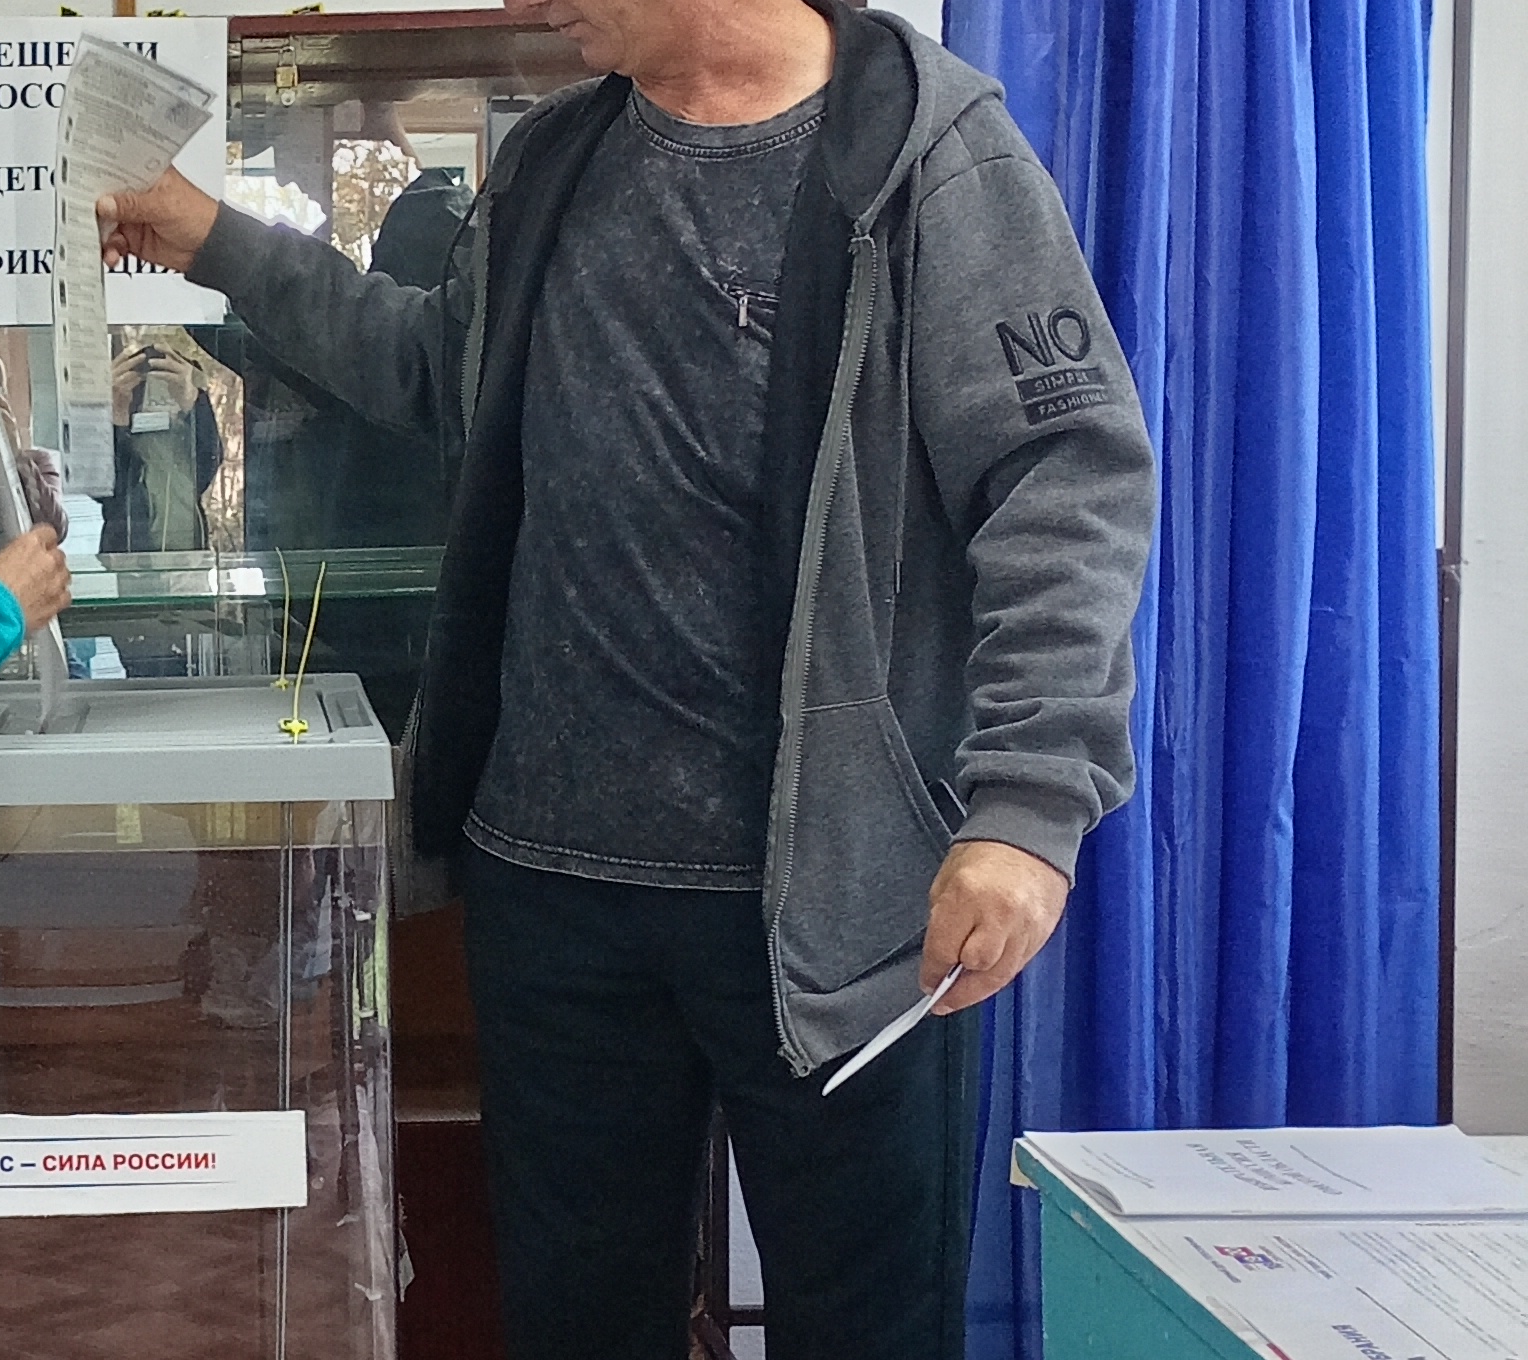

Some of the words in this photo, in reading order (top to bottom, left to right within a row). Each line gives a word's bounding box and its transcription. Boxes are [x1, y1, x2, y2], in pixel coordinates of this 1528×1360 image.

[995, 306, 1092, 377] NO
[42, 1154, 106, 1173] СИЛА
[113, 1152, 217, 1172] РОССИИ!
